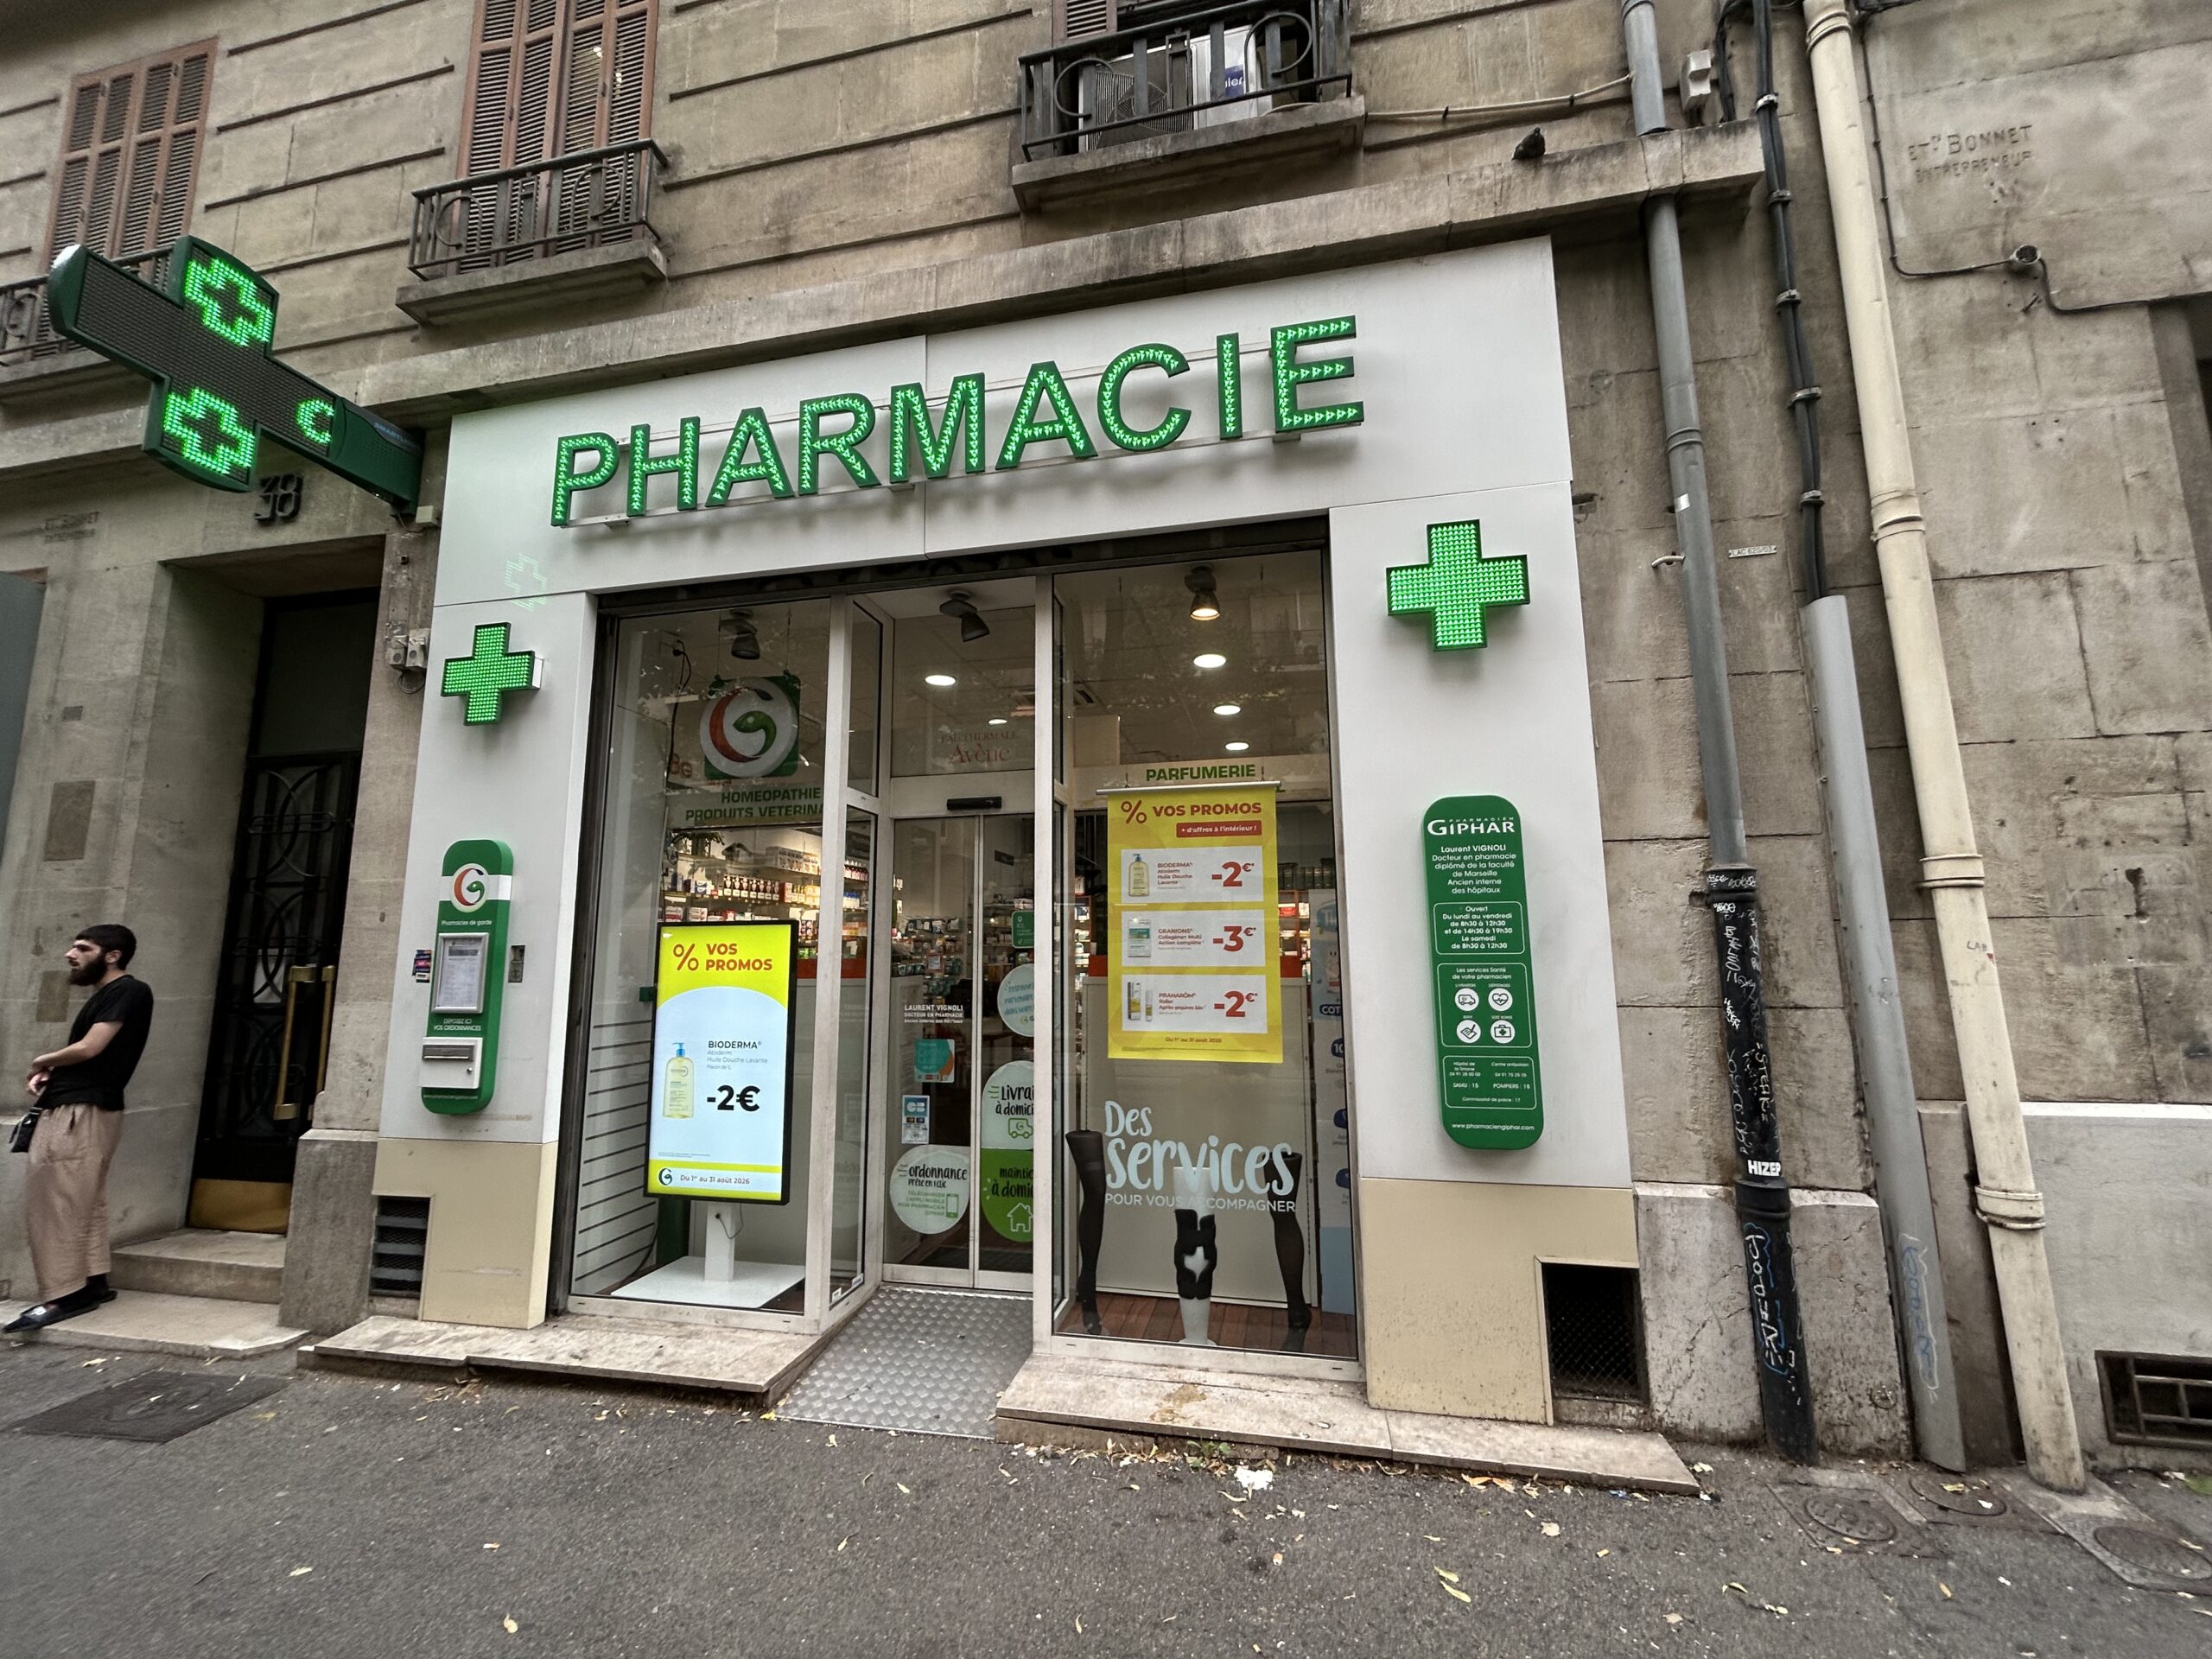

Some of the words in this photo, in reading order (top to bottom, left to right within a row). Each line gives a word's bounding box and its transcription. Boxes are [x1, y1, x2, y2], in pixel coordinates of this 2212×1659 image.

[1948, 124, 2032, 155] BONNET
[550, 315, 1364, 527] PHARMACIE
[1146, 764, 1255, 781] PARFUMERIE
[721, 787, 821, 804] HOMEOPATHIE
[685, 807, 754, 821] PRODUITS
[1152, 804, 1186, 817] VOS
[1190, 802, 1262, 816] PROMOS
[1427, 819, 1516, 836] GIPHAR
[706, 943, 738, 955] VOS
[705, 958, 772, 971] PROMOS
[707, 1084, 760, 1112] -2€
[995, 1101, 1001, 1115] à
[1104, 1100, 1152, 1137] Des
[908, 1163, 968, 1180] ordonnance
[1106, 1135, 1294, 1196] services
[908, 1178, 925, 1186] prête
[991, 1179, 1000, 1197] à
[1105, 1193, 1142, 1205] POUR
[1146, 1194, 1182, 1207] VOUS
[1188, 1196, 1296, 1212] ACCOMPAGNER
